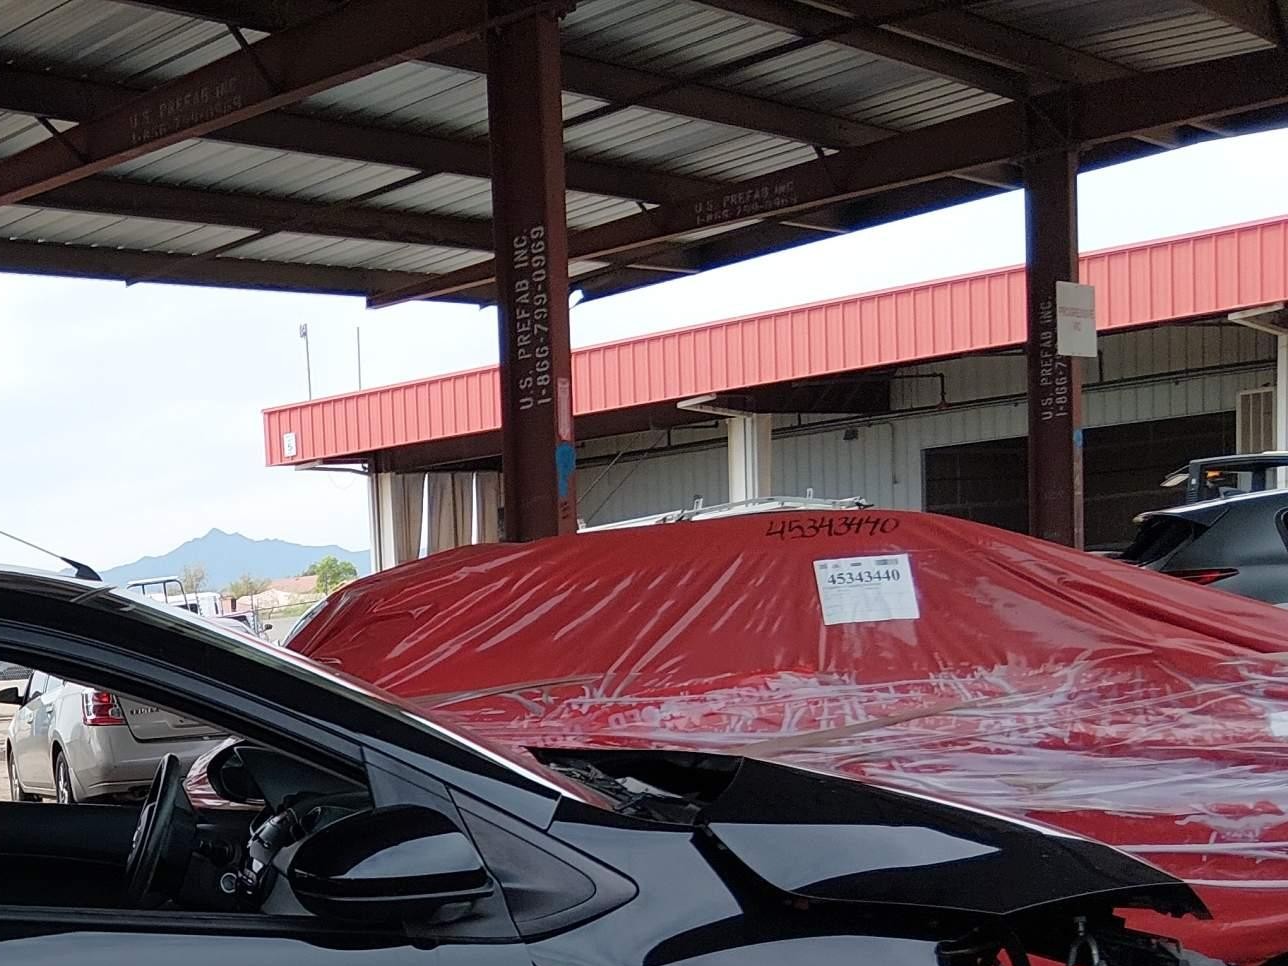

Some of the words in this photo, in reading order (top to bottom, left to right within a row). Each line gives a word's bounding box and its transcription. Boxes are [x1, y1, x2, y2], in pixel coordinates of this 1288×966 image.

[513, 228, 530, 270] INC.
[515, 279, 533, 361] PREFAB
[530, 225, 552, 406] 1-866-799-0969
[1039, 331, 1054, 387] PREFAB
[518, 369, 534, 410] U.S.
[765, 514, 901, 541] 45343440
[827, 568, 902, 586] 45343440
